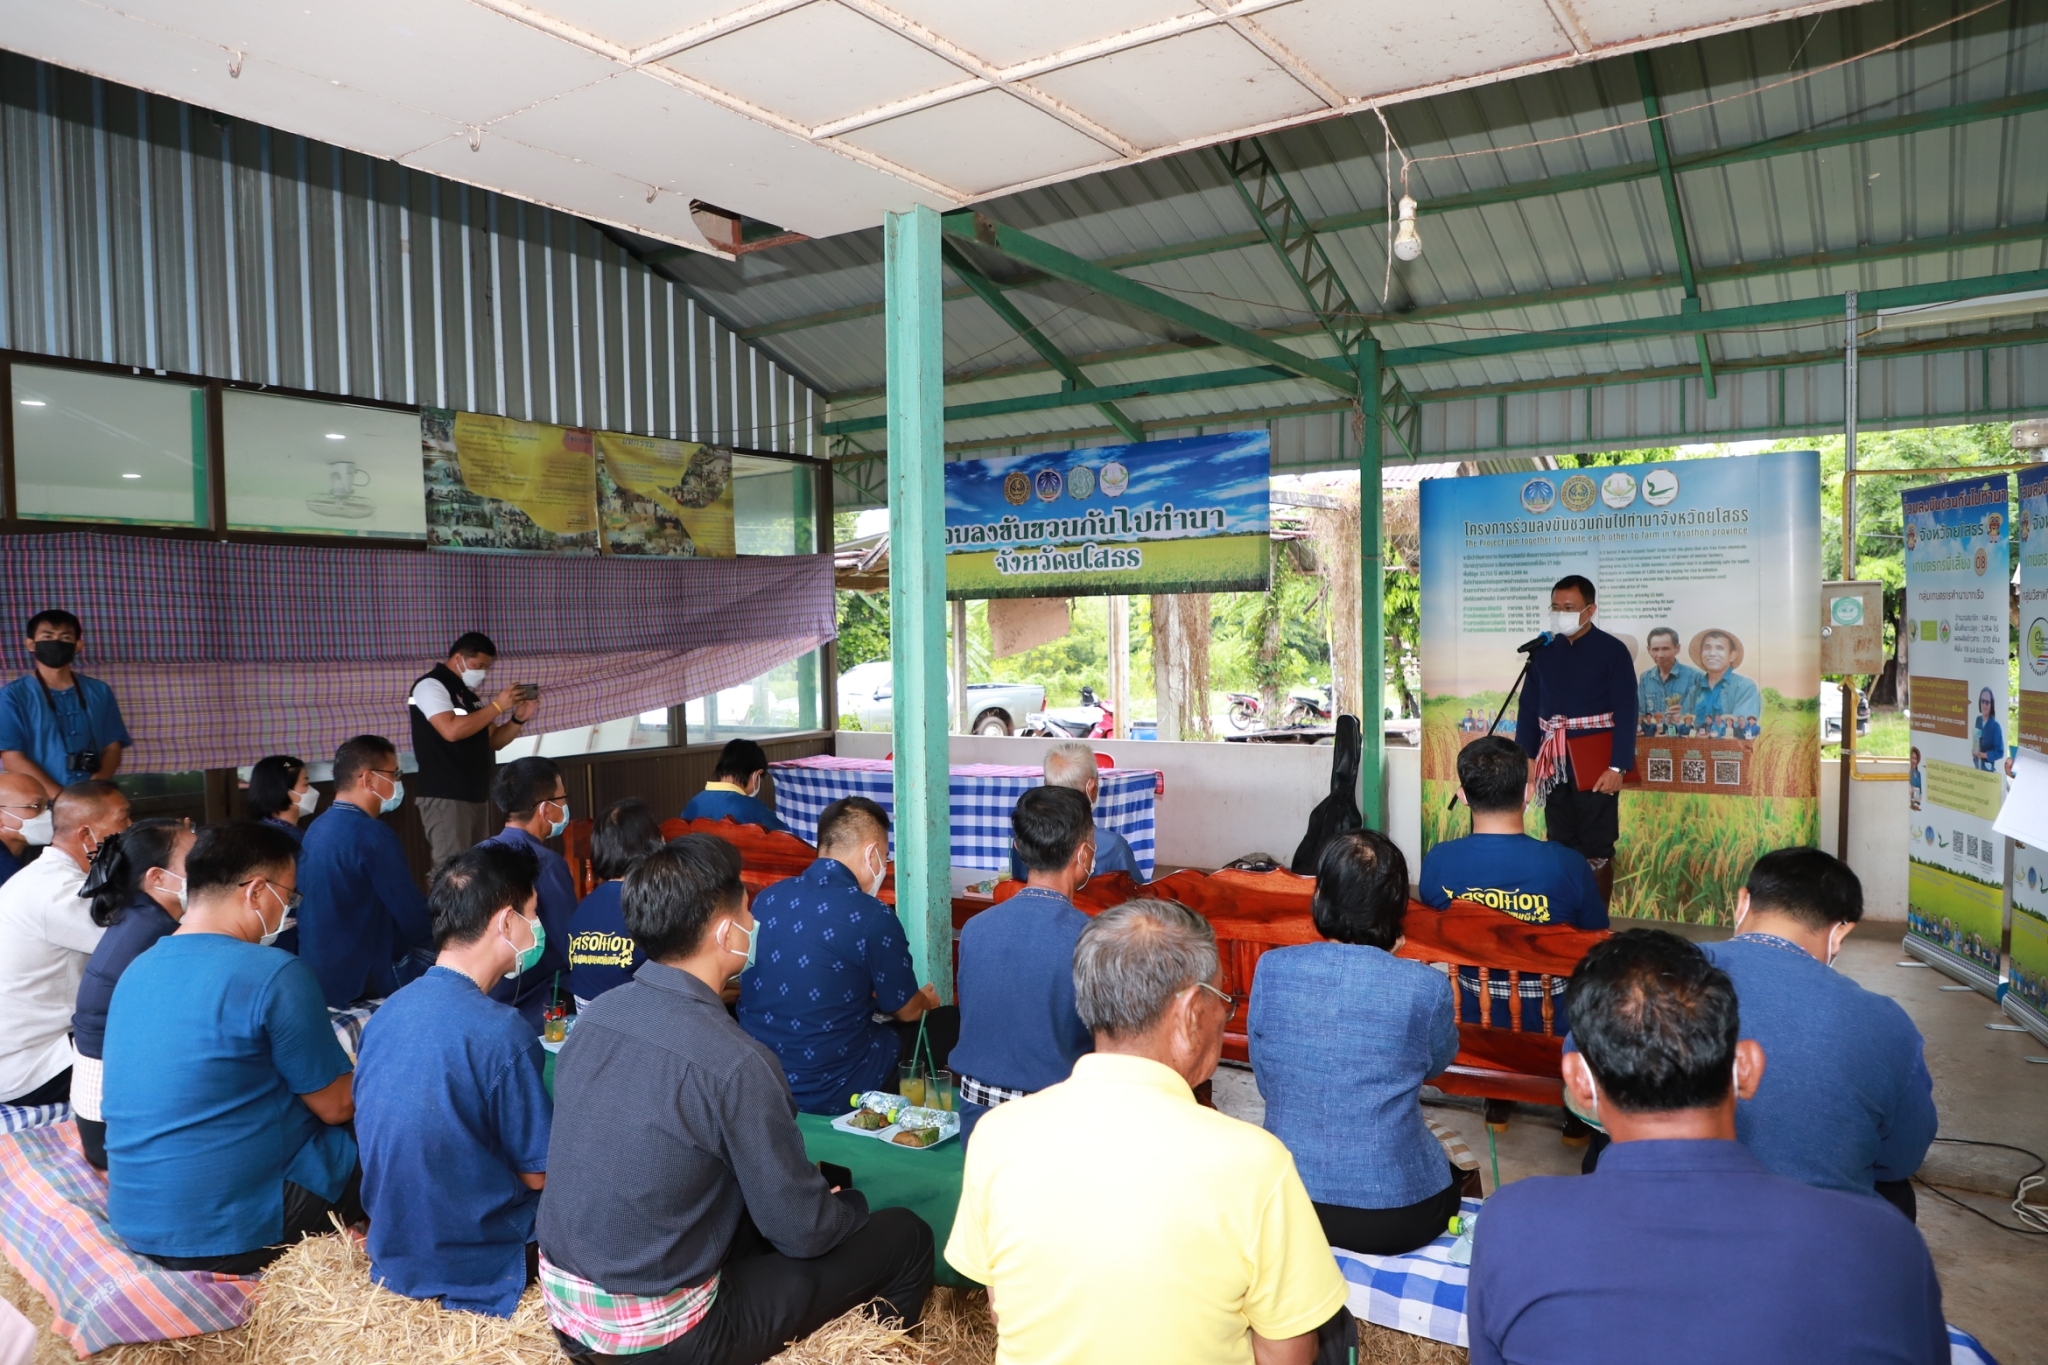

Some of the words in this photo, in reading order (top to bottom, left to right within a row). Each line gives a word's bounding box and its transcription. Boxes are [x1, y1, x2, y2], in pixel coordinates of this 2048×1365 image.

[945, 505, 1224, 545] วมลงขันชวนกันไปทำนา
[1919, 523, 1984, 541] จังหวัดยโสธร
[1465, 539, 1477, 547] The
[1480, 538, 1504, 548] Project
[1506, 538, 1519, 547] join
[1521, 537, 1551, 546] together
[1565, 535, 1585, 543] invite
[1589, 534, 1605, 542] each
[1608, 532, 1628, 541] other
[1631, 532, 1638, 540] to
[1641, 530, 1659, 539] farm
[1662, 530, 1669, 538] in
[1673, 528, 1709, 538] Yasothon
[1712, 526, 1748, 537] province
[995, 544, 1140, 573] จังหวัดยโสธร
[1912, 551, 1971, 573] เกษตรกรพี่เลี้ยง
[1975, 556, 1986, 569] 08
